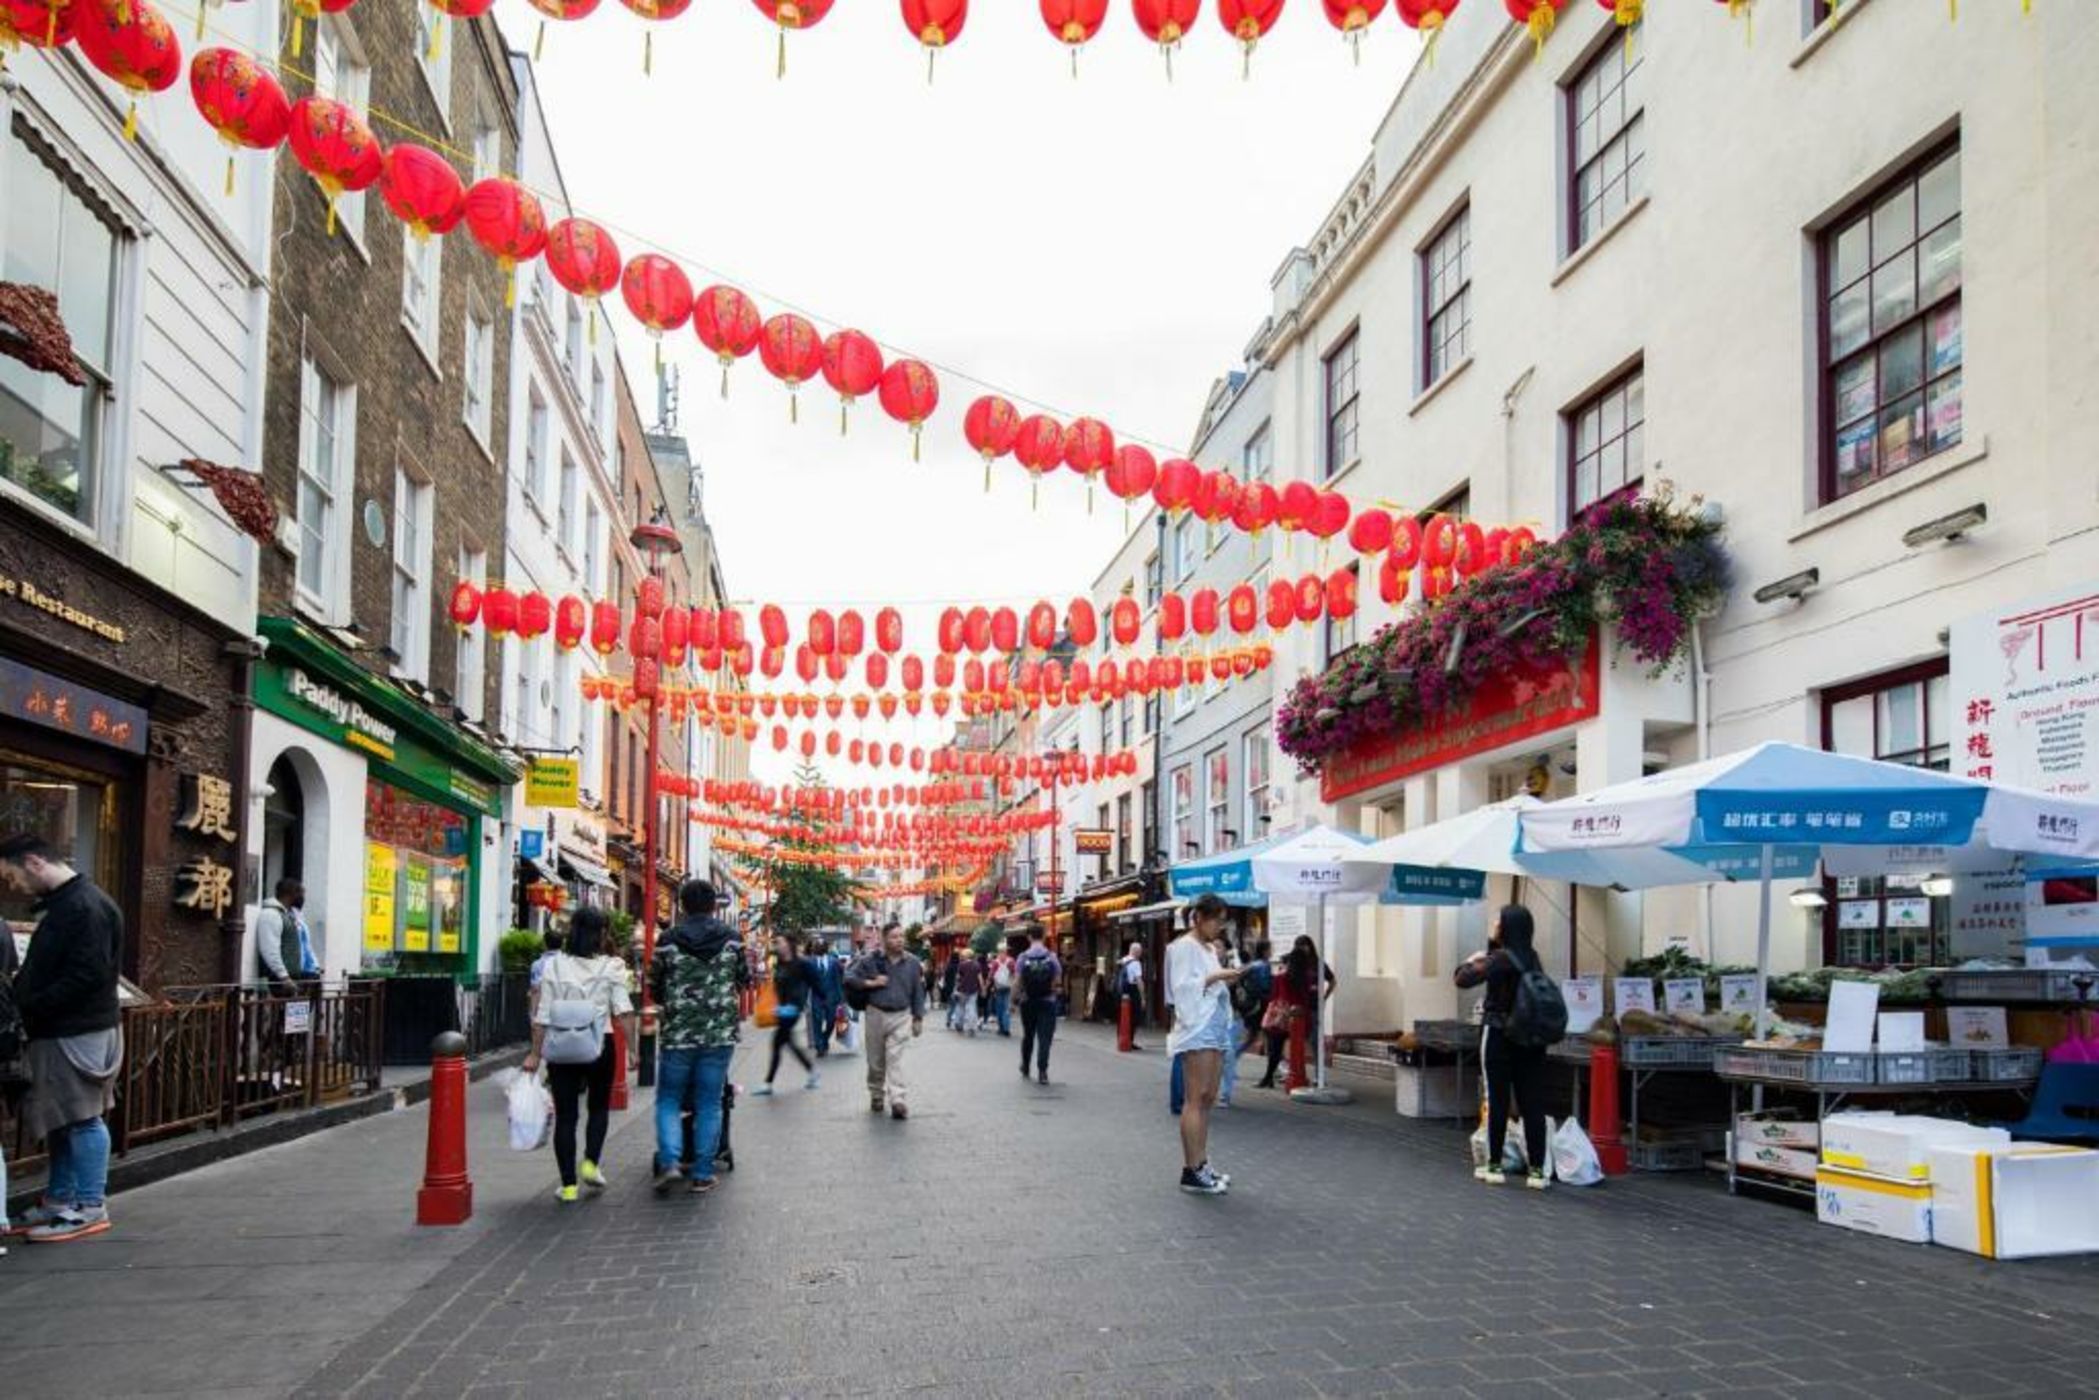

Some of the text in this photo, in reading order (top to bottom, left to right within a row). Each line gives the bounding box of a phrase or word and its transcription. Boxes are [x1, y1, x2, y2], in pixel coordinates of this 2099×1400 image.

[21, 580, 125, 643] Restaurant
[2006, 686, 2054, 701] Authentic
[290, 667, 397, 744] Paddy Power
[2020, 703, 2063, 720] Ground
[532, 777, 571, 788] Power
